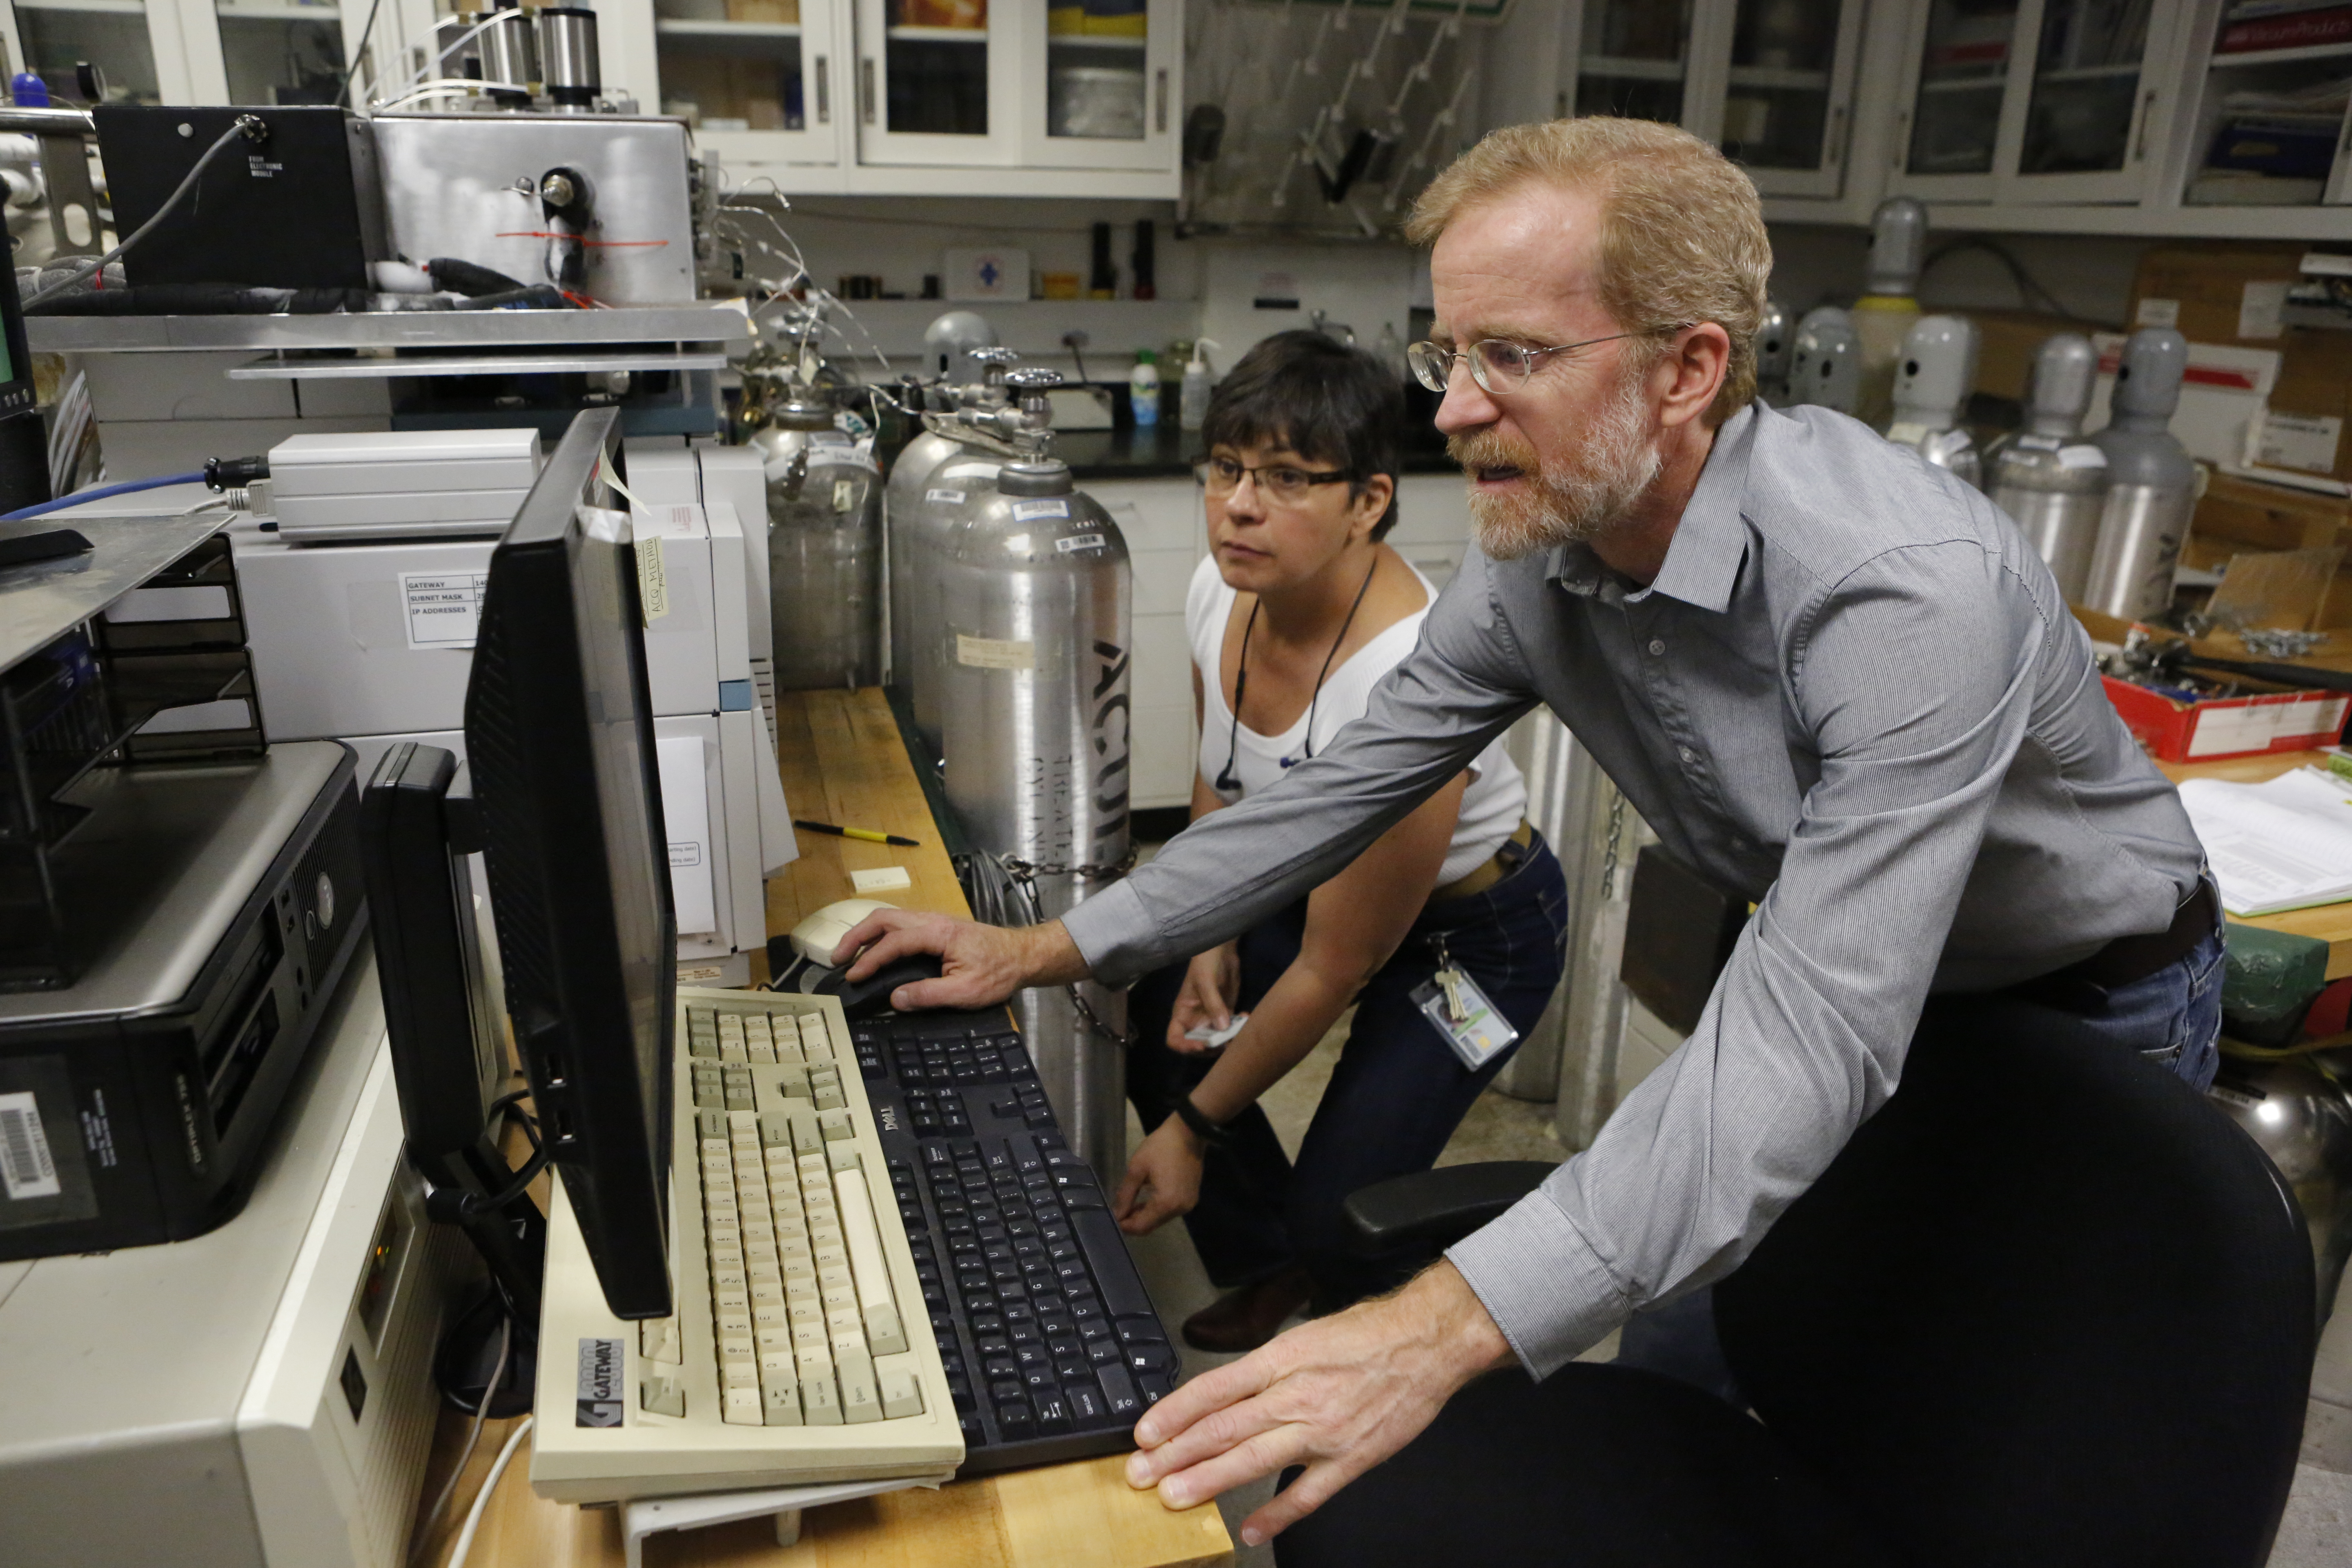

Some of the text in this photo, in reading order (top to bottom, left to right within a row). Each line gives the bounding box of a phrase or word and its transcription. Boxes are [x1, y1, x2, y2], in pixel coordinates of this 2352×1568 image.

[646, 539, 661, 612] ACQ METHOD
[880, 1105, 898, 1131] DELL
[594, 1340, 612, 1399] GATEWAY
